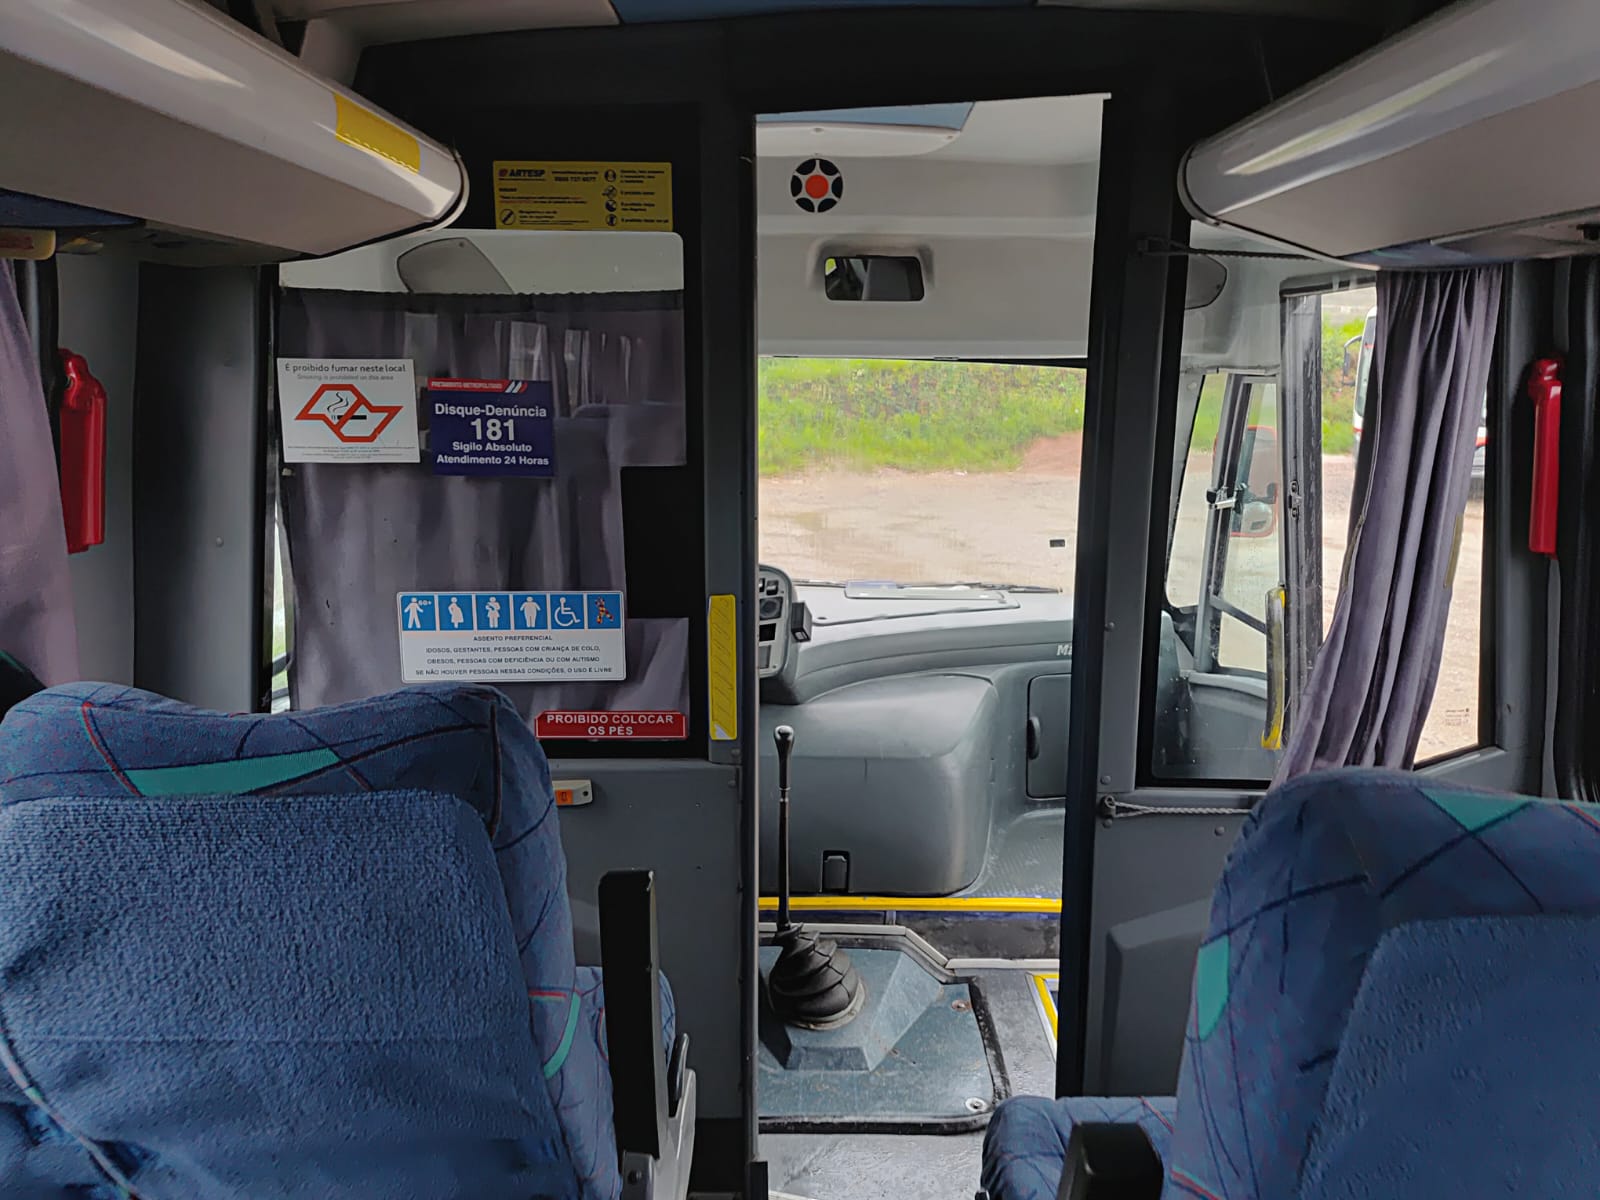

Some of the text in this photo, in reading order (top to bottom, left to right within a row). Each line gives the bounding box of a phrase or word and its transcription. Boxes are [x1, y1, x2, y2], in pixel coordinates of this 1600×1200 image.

[509, 169, 546, 177] ARTESP
[285, 363, 290, 371] É
[293, 364, 329, 373] proibido
[385, 364, 406, 372] local
[434, 403, 547, 418] Disque-Denúncia
[470, 418, 515, 441] 181
[452, 441, 532, 453] Sigilo Absoluto
[436, 454, 549, 466] Atendimento 24 Horas
[541, 645, 570, 653] CRIANÇA
[546, 714, 674, 724] PROIBIDO COLOCAR
[587, 724, 633, 735] OS PÉS
